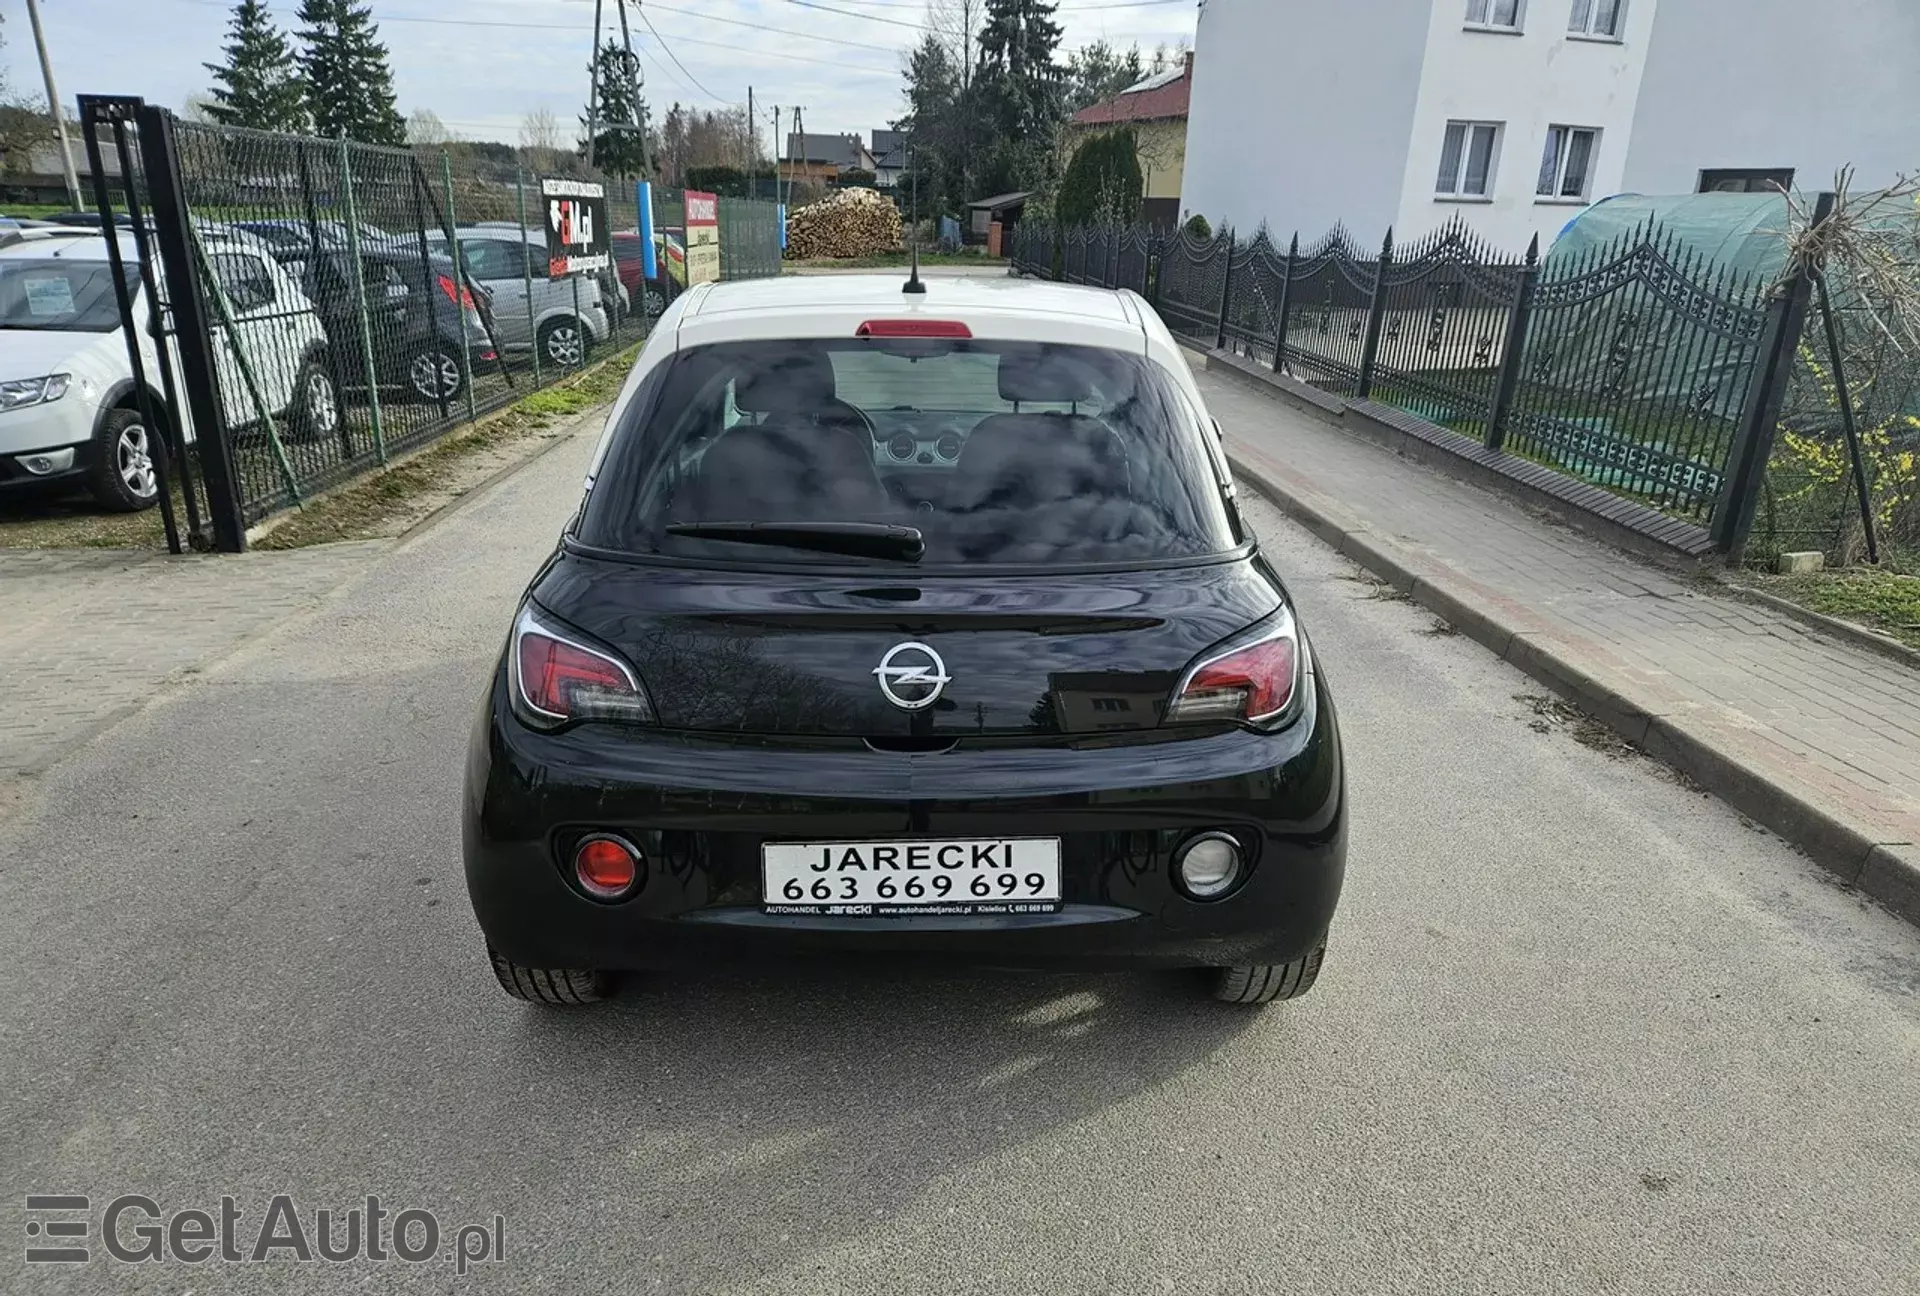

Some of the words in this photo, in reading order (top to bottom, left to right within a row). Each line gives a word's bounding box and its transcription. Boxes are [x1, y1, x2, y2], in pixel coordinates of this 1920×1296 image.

[810, 844, 1013, 872] JARECKI
[782, 876, 858, 900] 663
[877, 874, 953, 898] 669
[970, 872, 1045, 897] 699
[765, 905, 821, 914] AUTOHANDEL
[878, 904, 972, 915] www.autohandeljarecki.pl
[1015, 904, 1027, 912] 663
